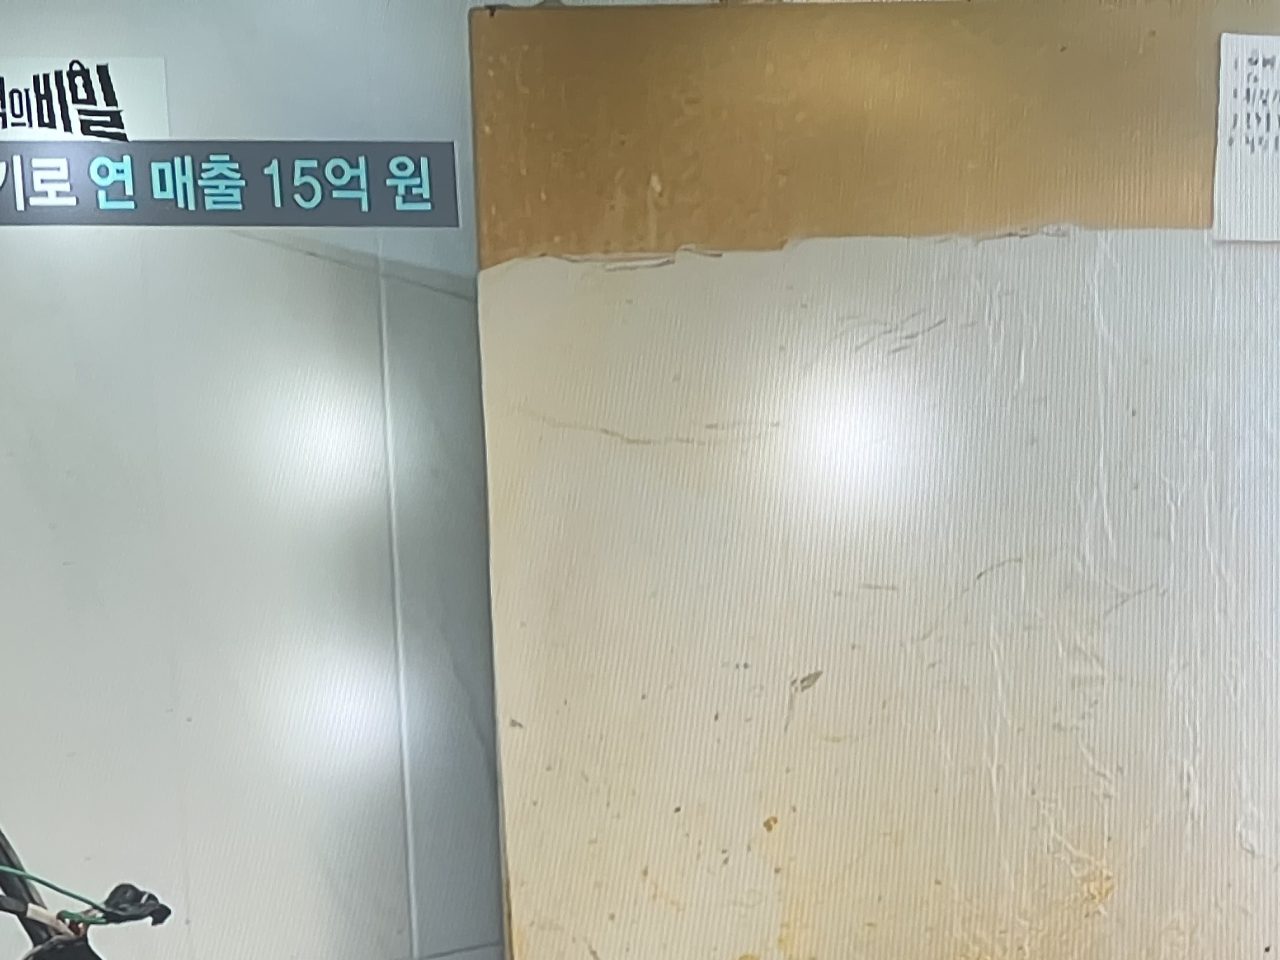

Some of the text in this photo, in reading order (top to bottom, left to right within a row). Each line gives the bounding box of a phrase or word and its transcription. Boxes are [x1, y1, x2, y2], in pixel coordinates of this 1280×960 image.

[89, 154, 136, 211] 연
[150, 154, 246, 211] 매출
[263, 155, 369, 213] 15억
[386, 155, 432, 211] 원
